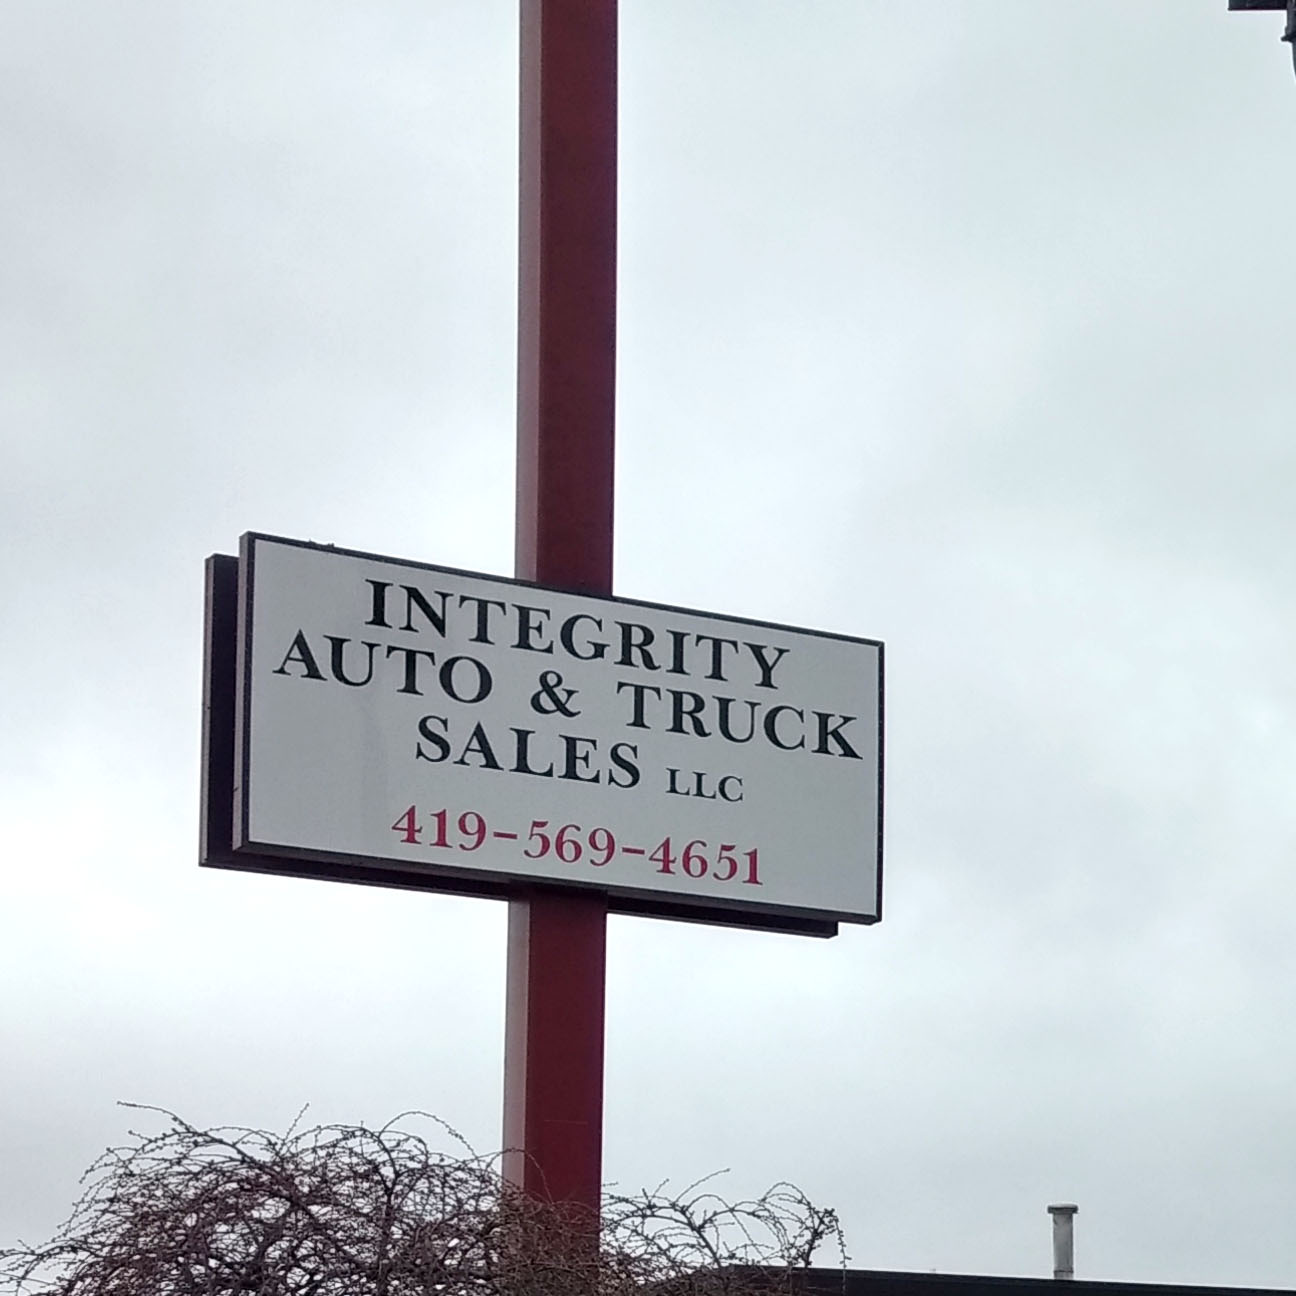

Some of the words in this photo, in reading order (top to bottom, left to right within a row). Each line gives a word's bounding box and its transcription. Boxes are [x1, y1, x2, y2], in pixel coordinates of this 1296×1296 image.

[364, 578, 791, 690] INTEGRITY
[271, 628, 493, 704] AUTO
[530, 670, 582, 718] &
[616, 681, 864, 761] TRUCK
[415, 715, 641, 789] SALES
[665, 767, 743, 803] LLC
[391, 805, 763, 886] 419-569-4651
